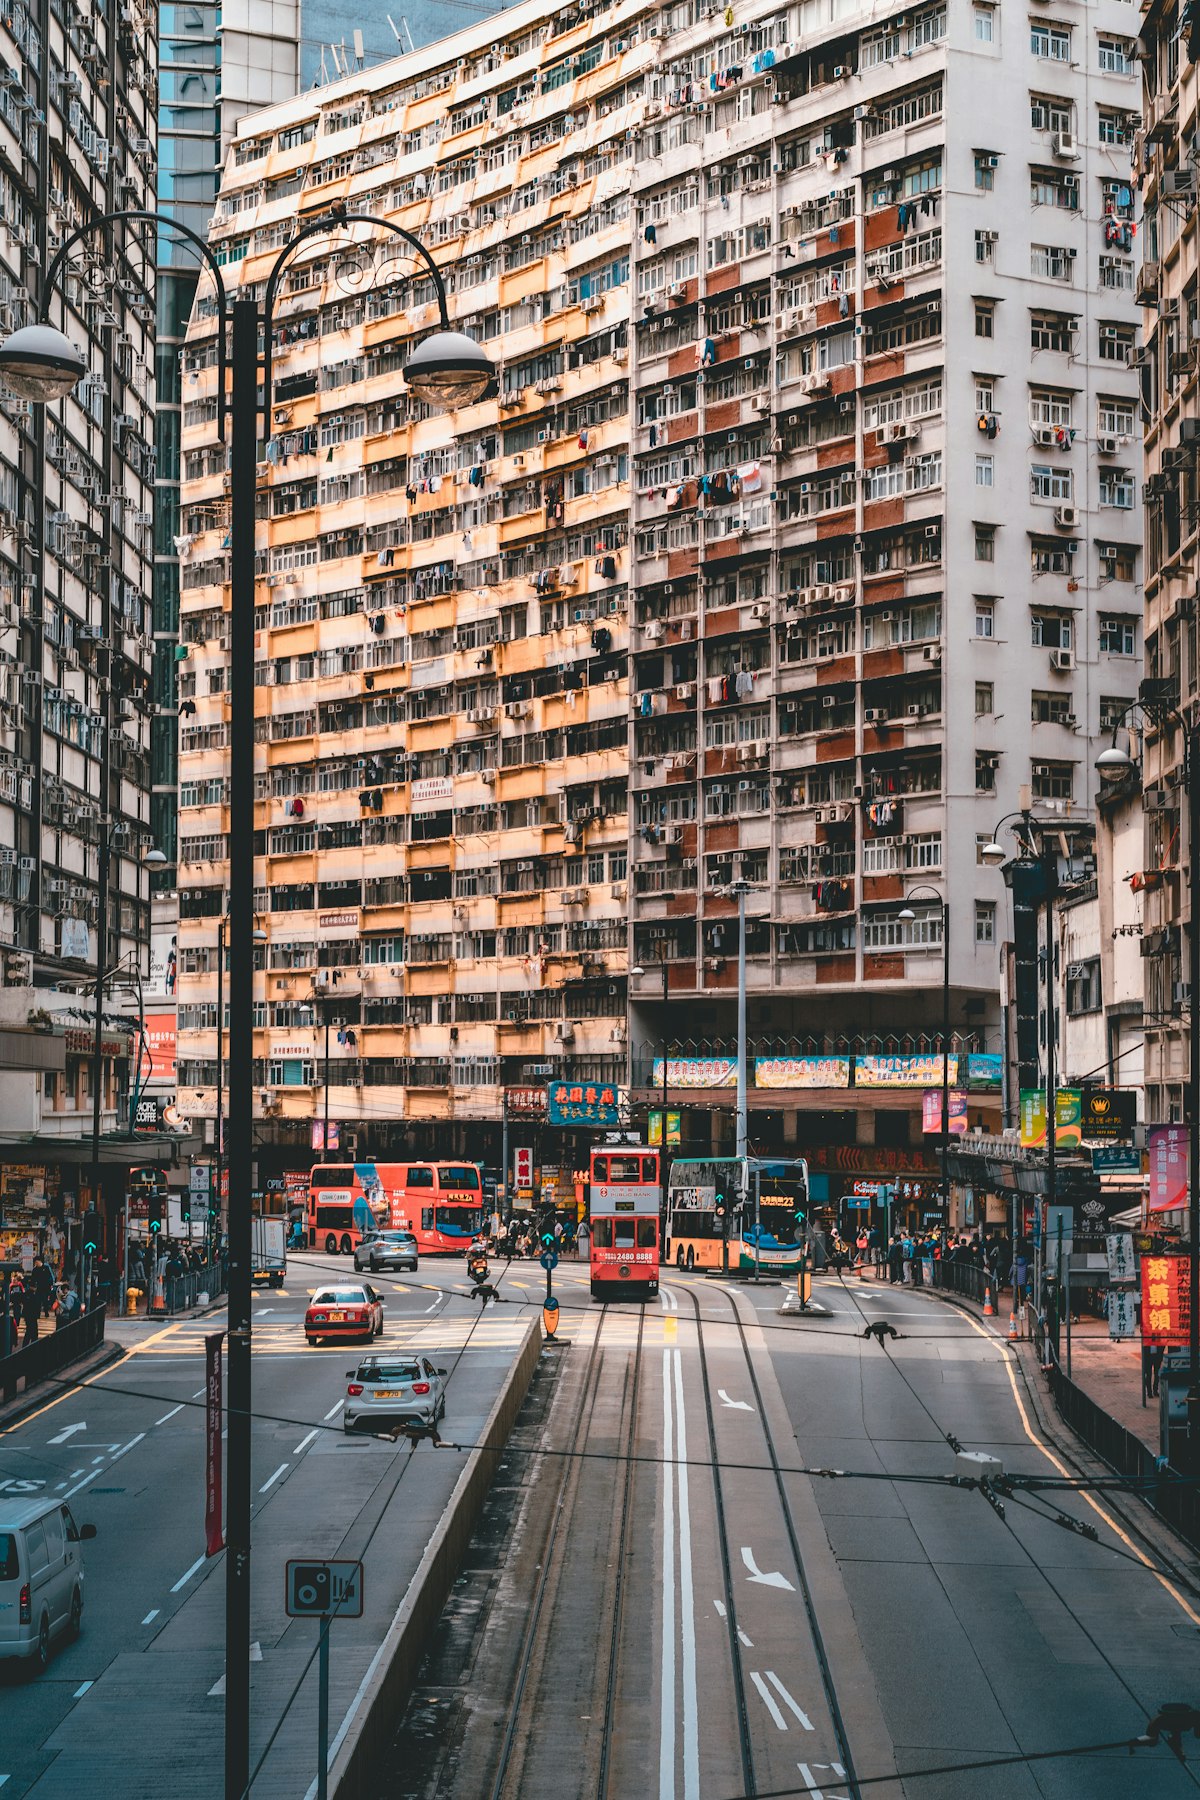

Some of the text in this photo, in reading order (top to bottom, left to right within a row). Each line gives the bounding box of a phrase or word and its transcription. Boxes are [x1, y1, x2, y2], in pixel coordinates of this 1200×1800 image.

[136, 1112, 156, 1122] COFFEE
[1168, 1129, 1178, 1163] 第七屆
